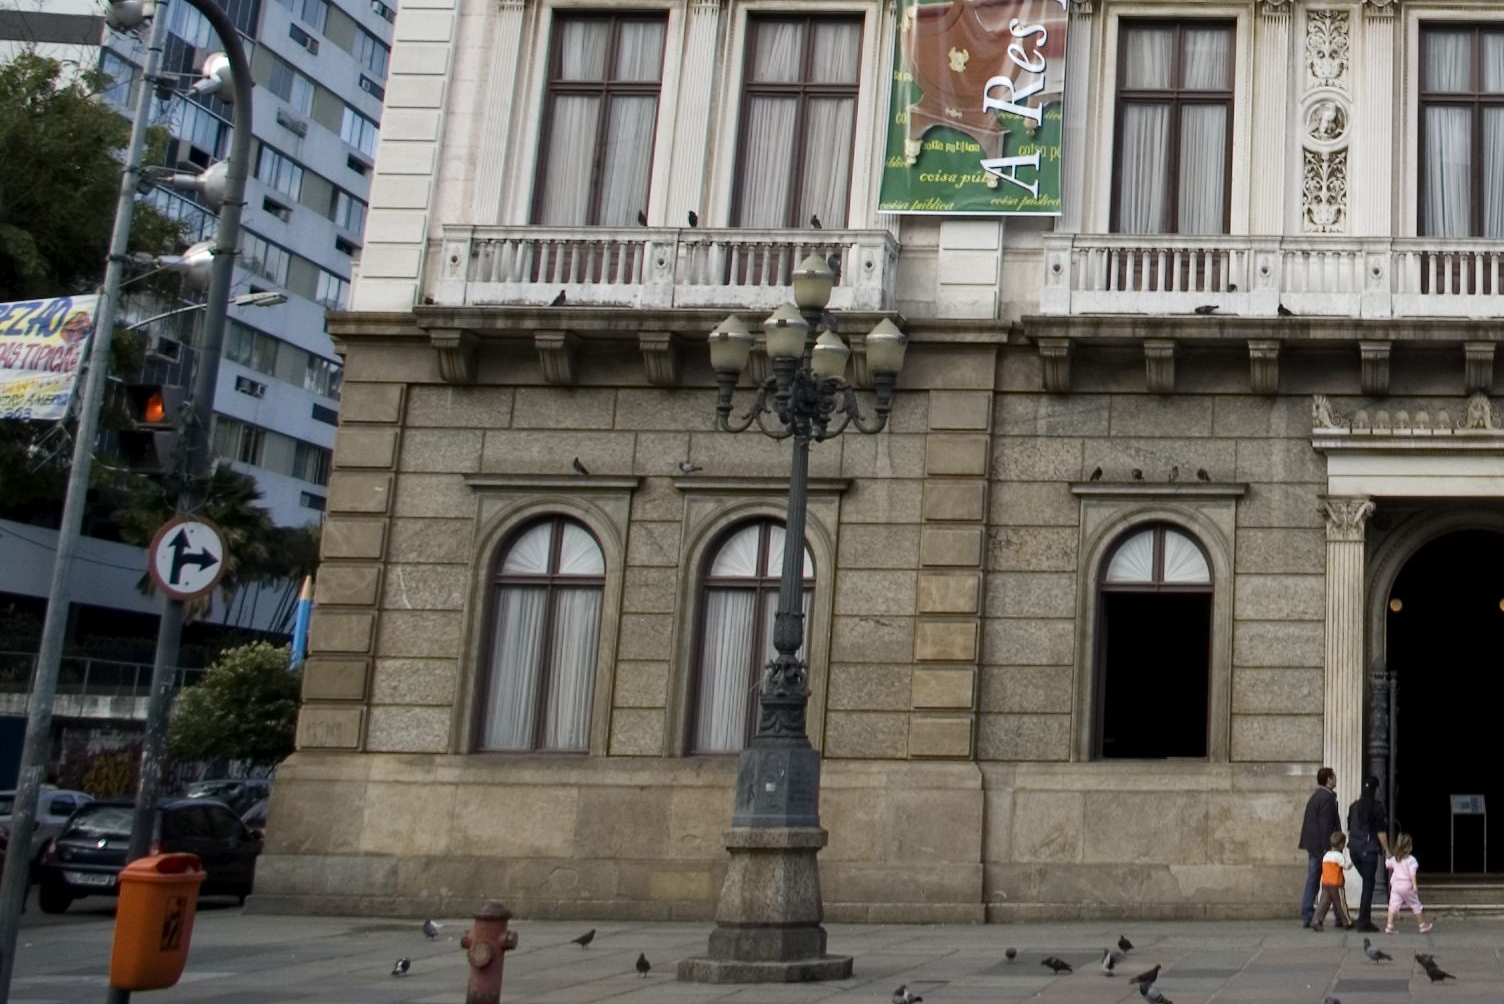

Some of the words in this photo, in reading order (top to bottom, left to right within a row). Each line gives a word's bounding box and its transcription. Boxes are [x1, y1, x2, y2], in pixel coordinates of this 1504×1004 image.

[983, 18, 1047, 126] Res
[919, 169, 958, 183] coisa
[980, 150, 1041, 200] A
